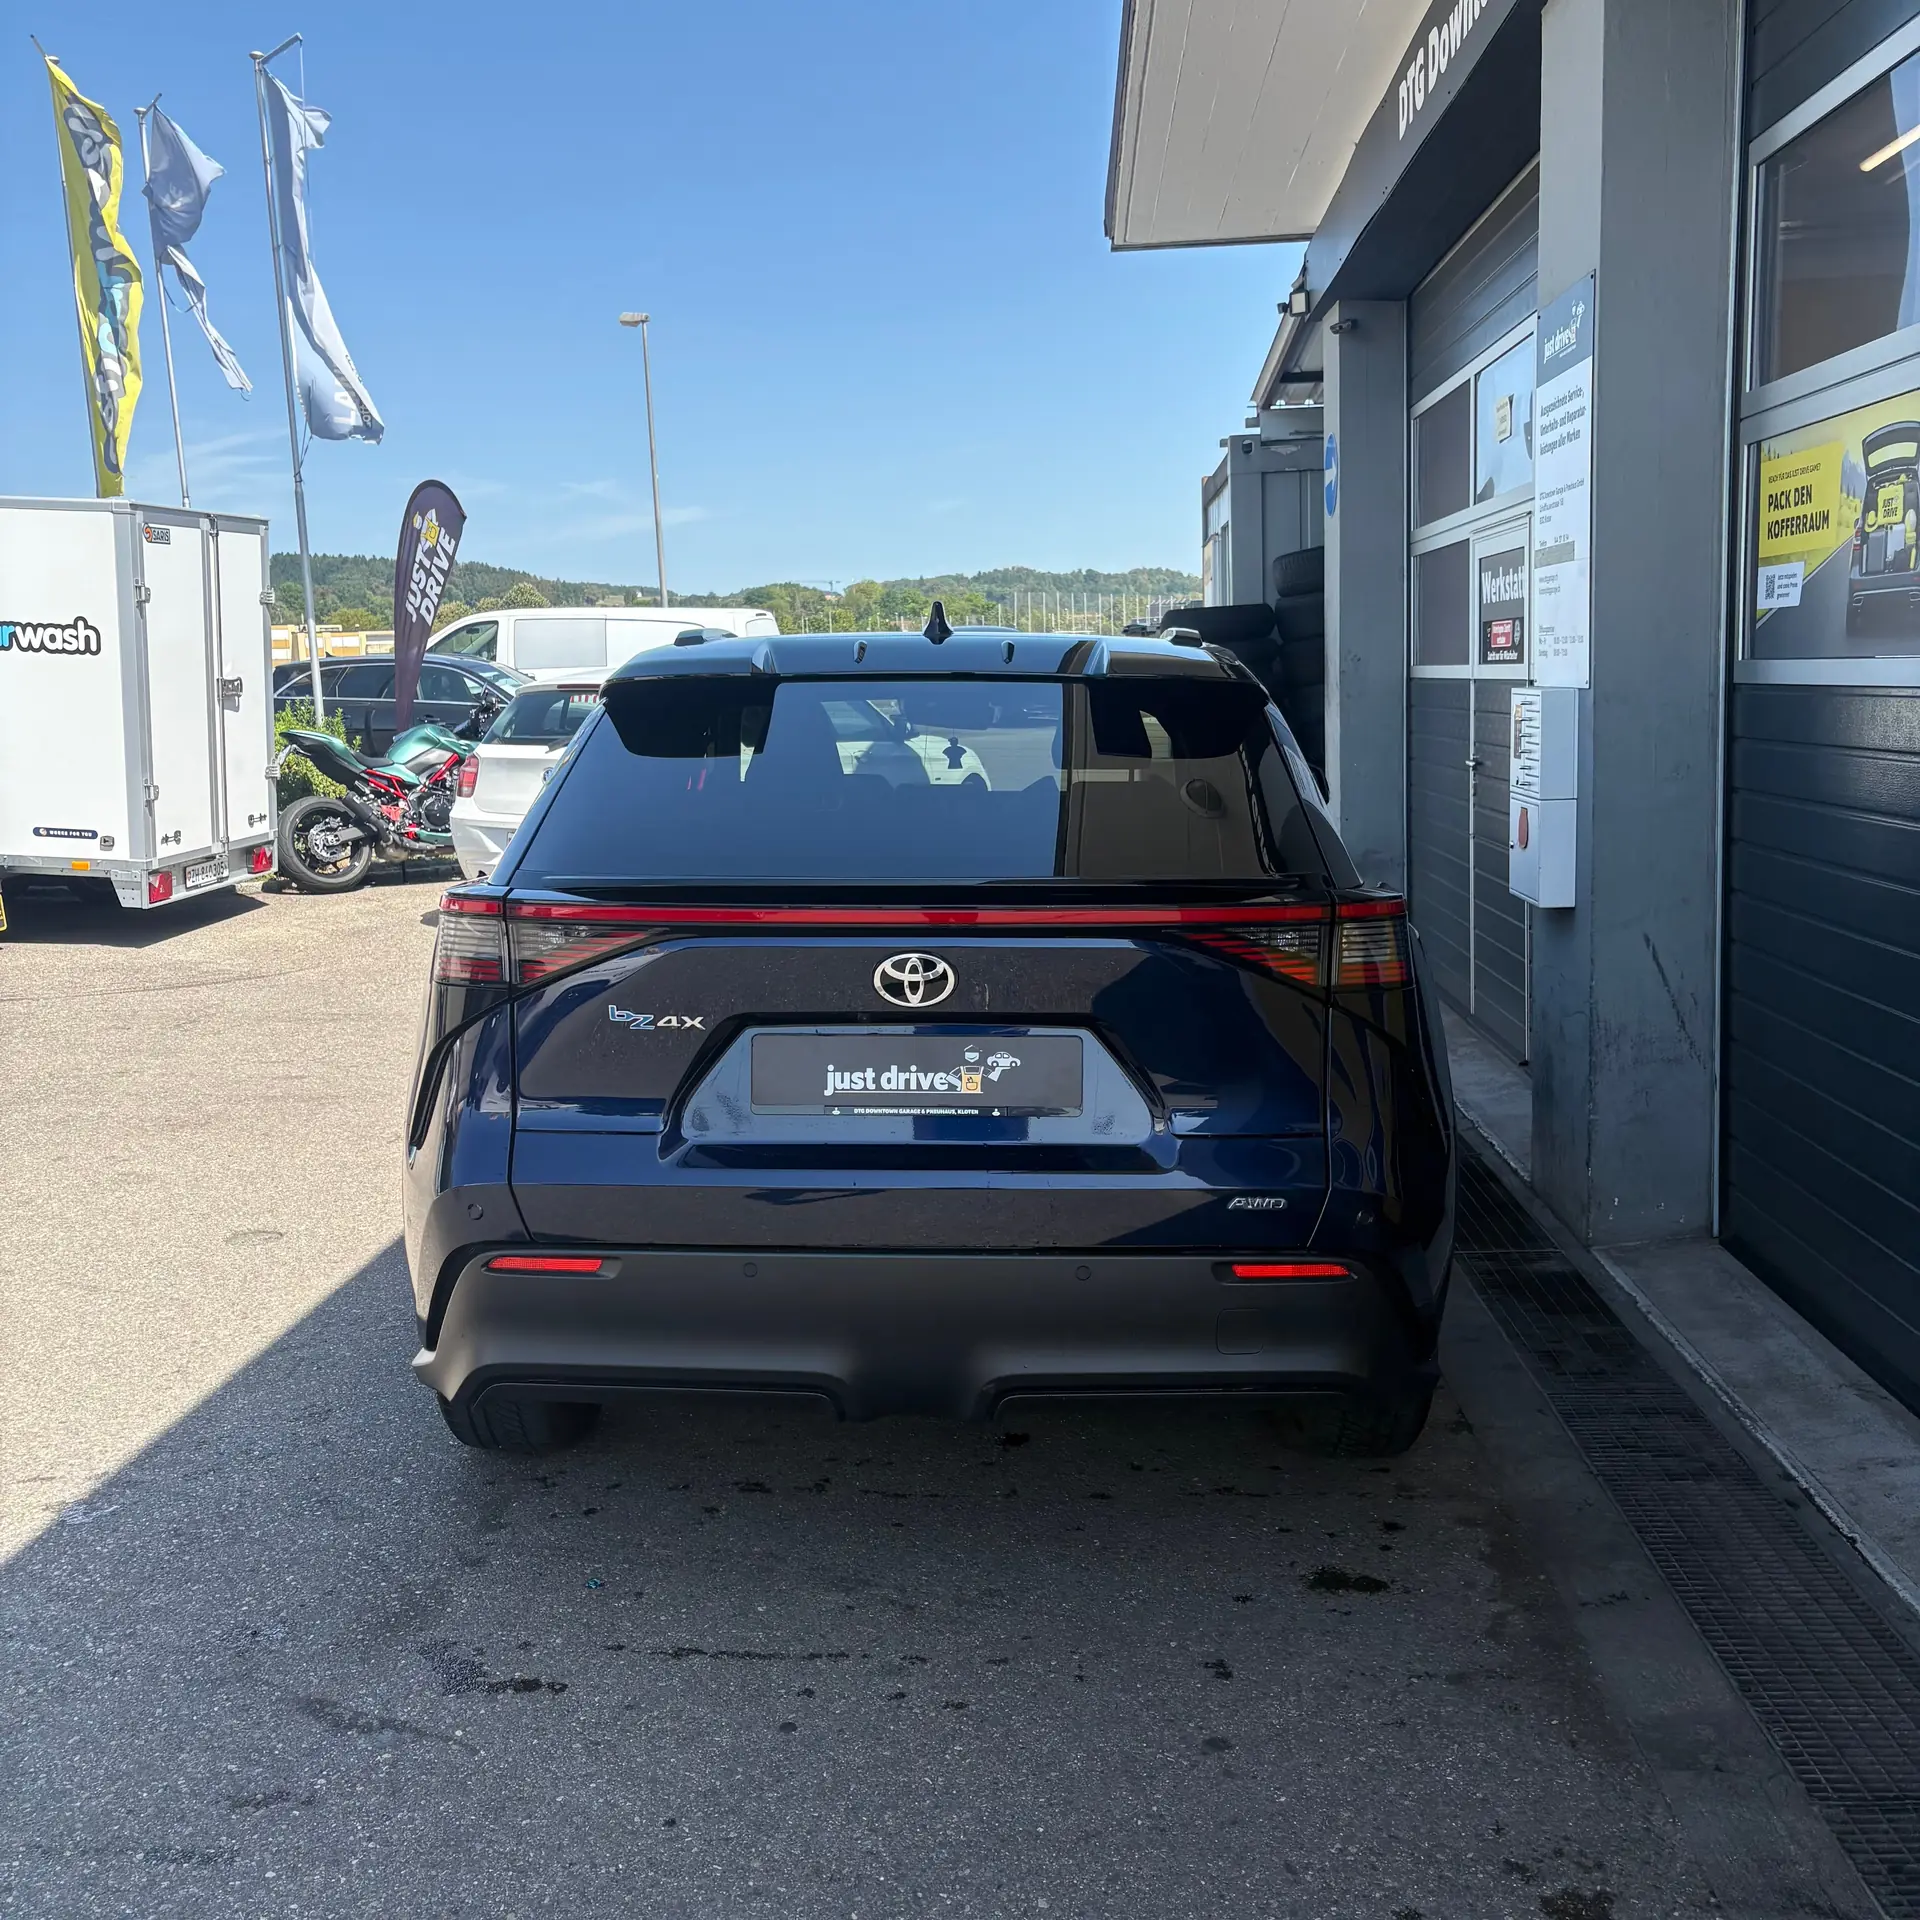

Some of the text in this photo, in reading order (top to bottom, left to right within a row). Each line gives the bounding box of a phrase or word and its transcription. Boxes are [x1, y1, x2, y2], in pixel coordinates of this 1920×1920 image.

[1399, 0, 1488, 141] DTG Down
[1768, 484, 1813, 513] PACK DEN
[152, 529, 169, 542] SARIS
[1767, 509, 1830, 540] KOFFERRAUM
[405, 543, 431, 623] JUST
[420, 527, 456, 627] DRIVE
[0, 617, 100, 654] rwash
[824, 1064, 949, 1096] just drive
[1227, 1197, 1287, 1210] AWD
